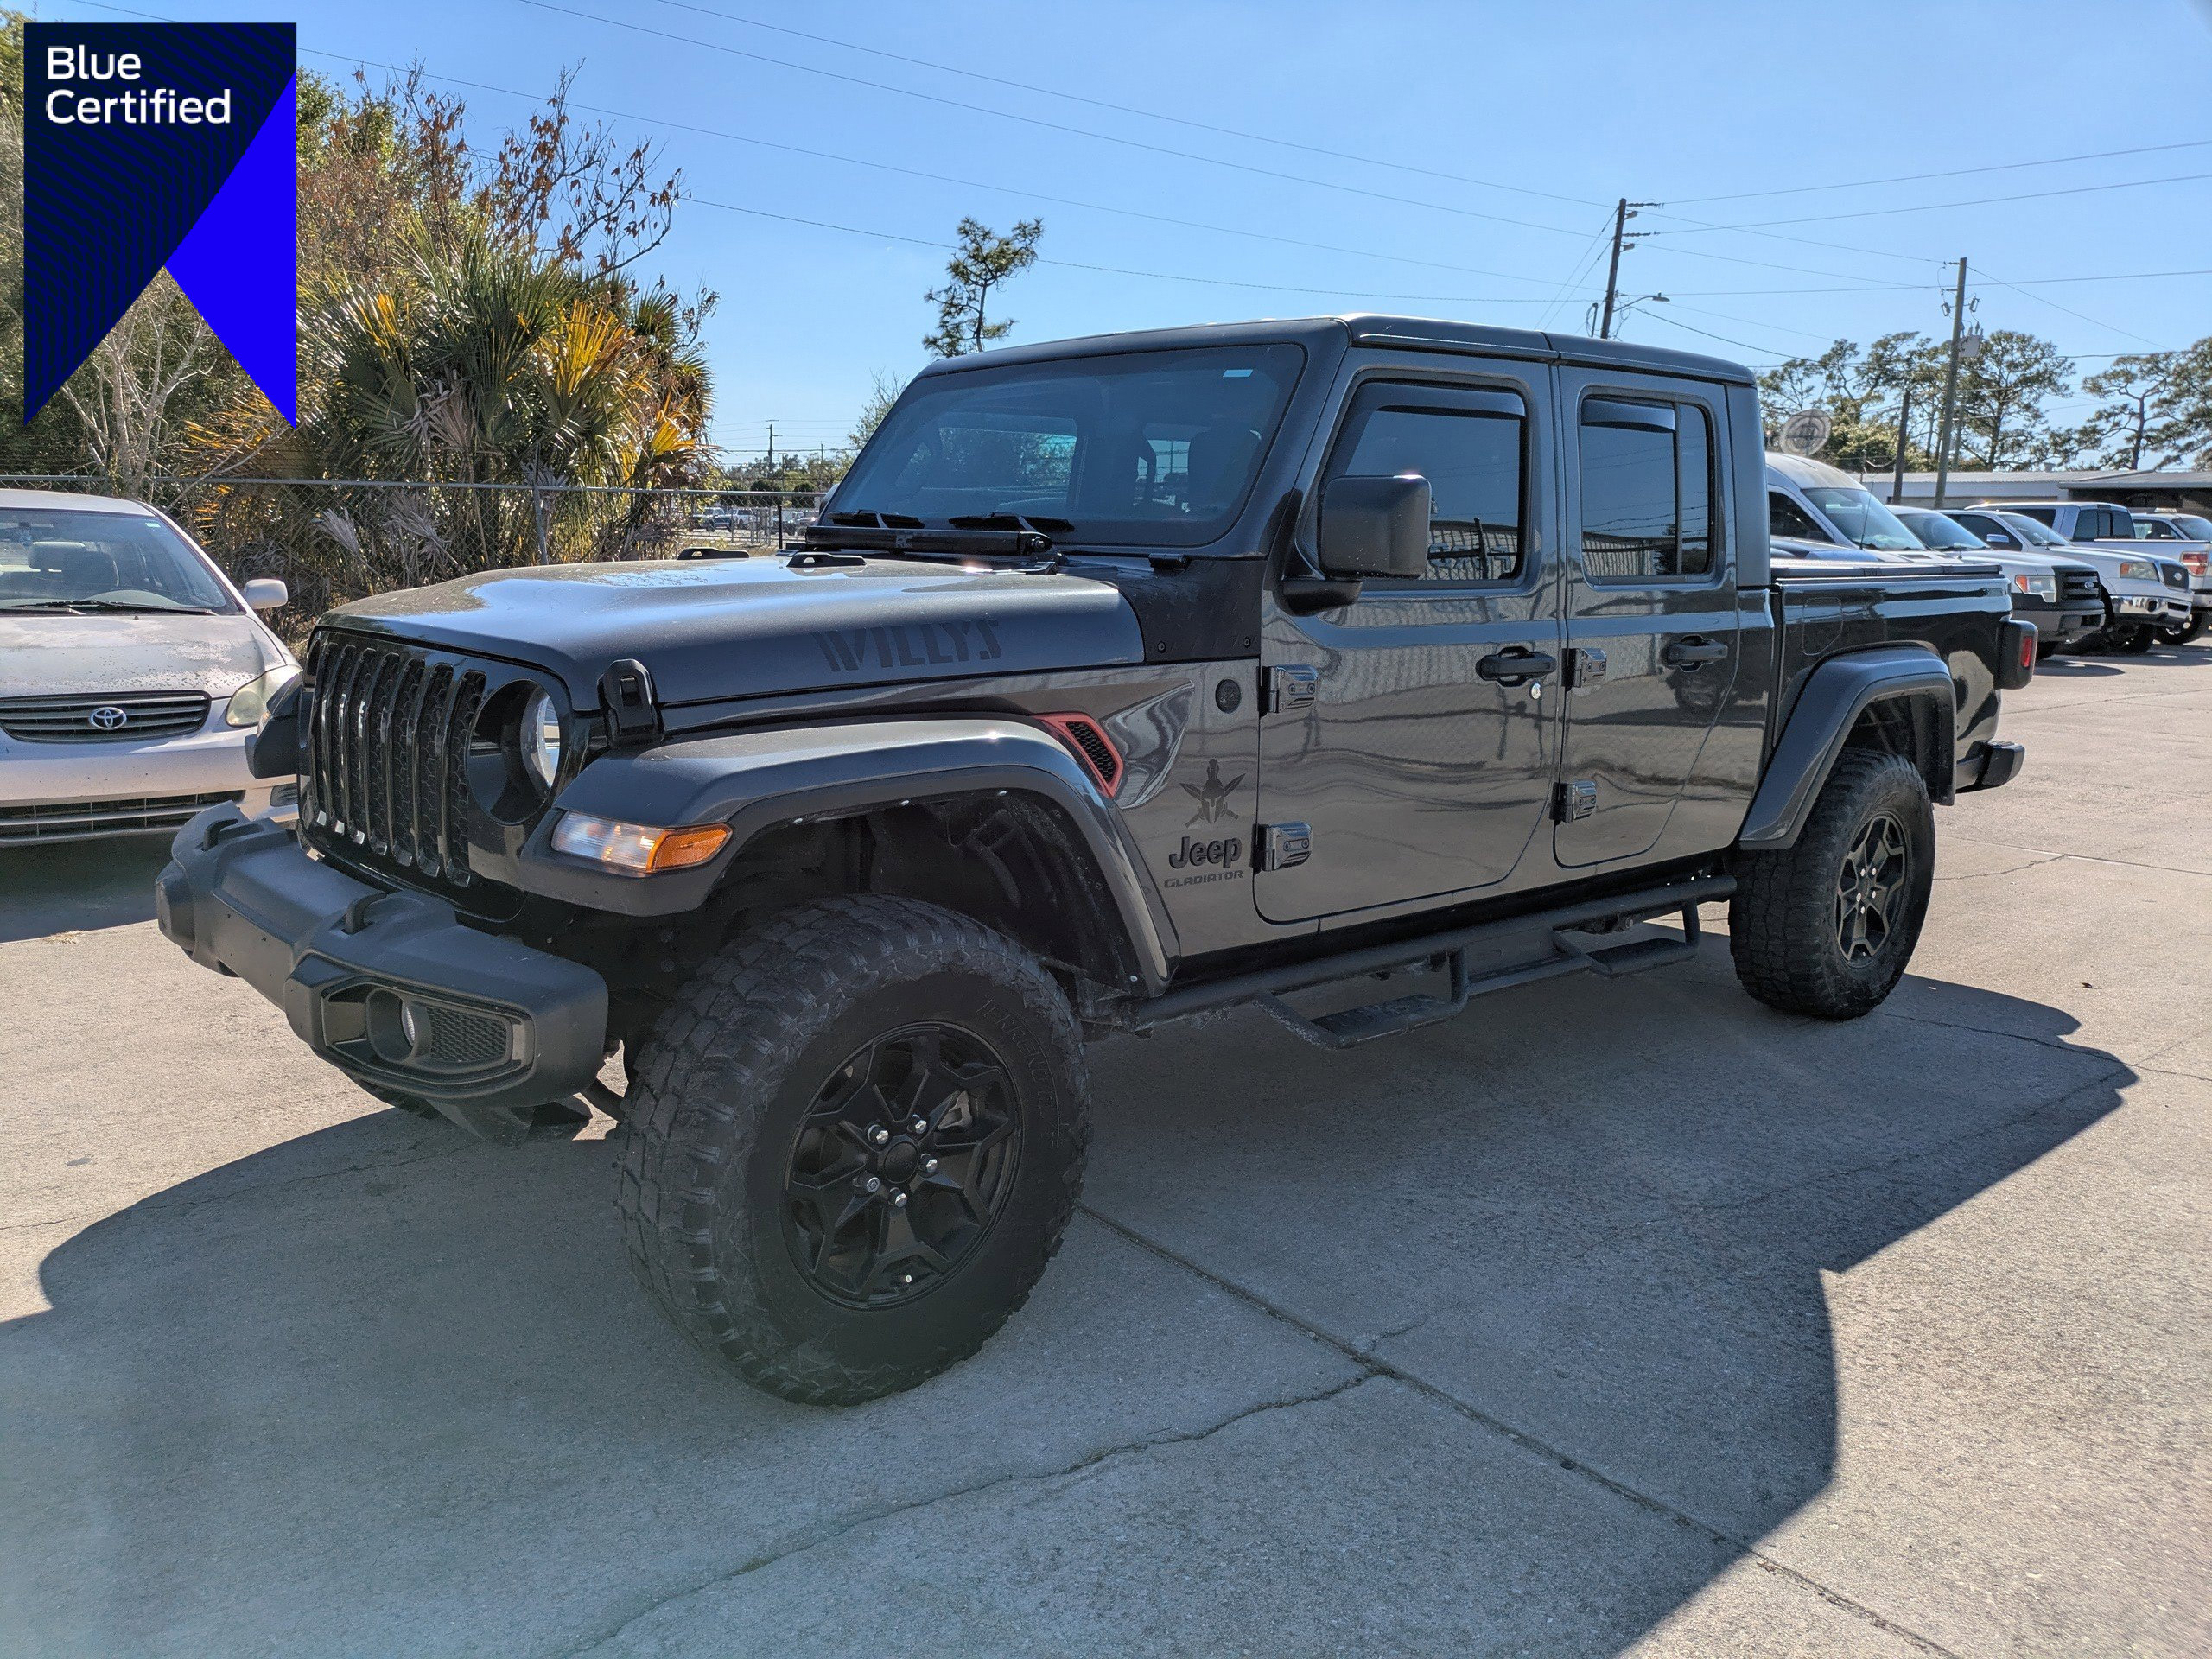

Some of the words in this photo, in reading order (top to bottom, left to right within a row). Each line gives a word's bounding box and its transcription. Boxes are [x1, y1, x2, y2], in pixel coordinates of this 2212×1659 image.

[810, 619, 1001, 672] WILLYS
[1168, 836, 1243, 869] Jeep
[1164, 870, 1243, 888] GLADIATOR
